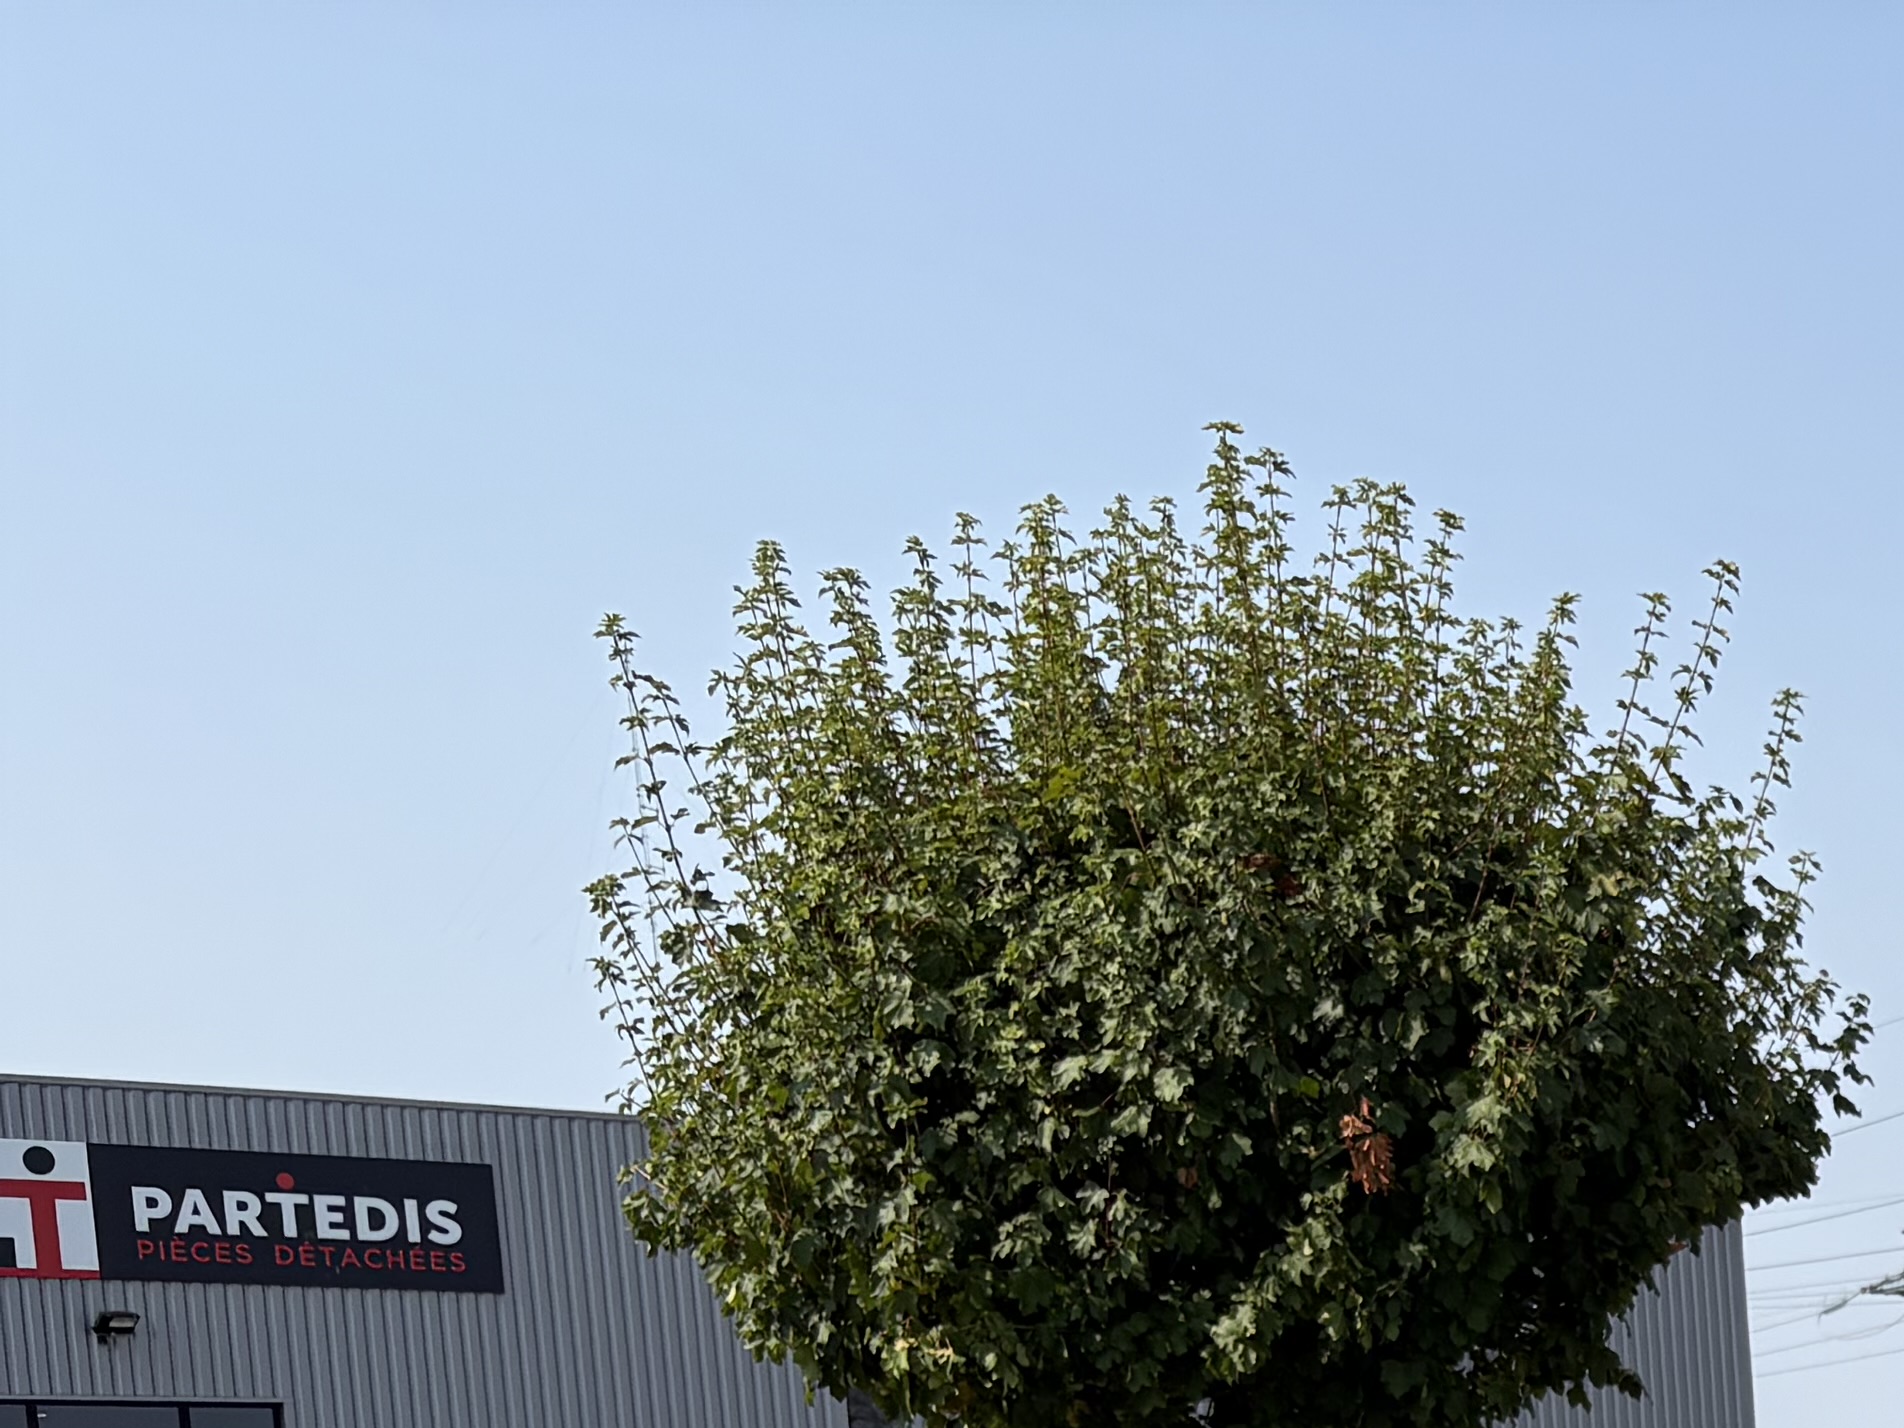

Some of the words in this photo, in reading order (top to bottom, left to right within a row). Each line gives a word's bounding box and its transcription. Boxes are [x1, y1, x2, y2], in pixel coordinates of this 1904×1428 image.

[131, 1184, 464, 1246] PARTEDIS
[137, 1236, 254, 1265] PIÈCES
[274, 1241, 467, 1273] DÉTACHÉES
